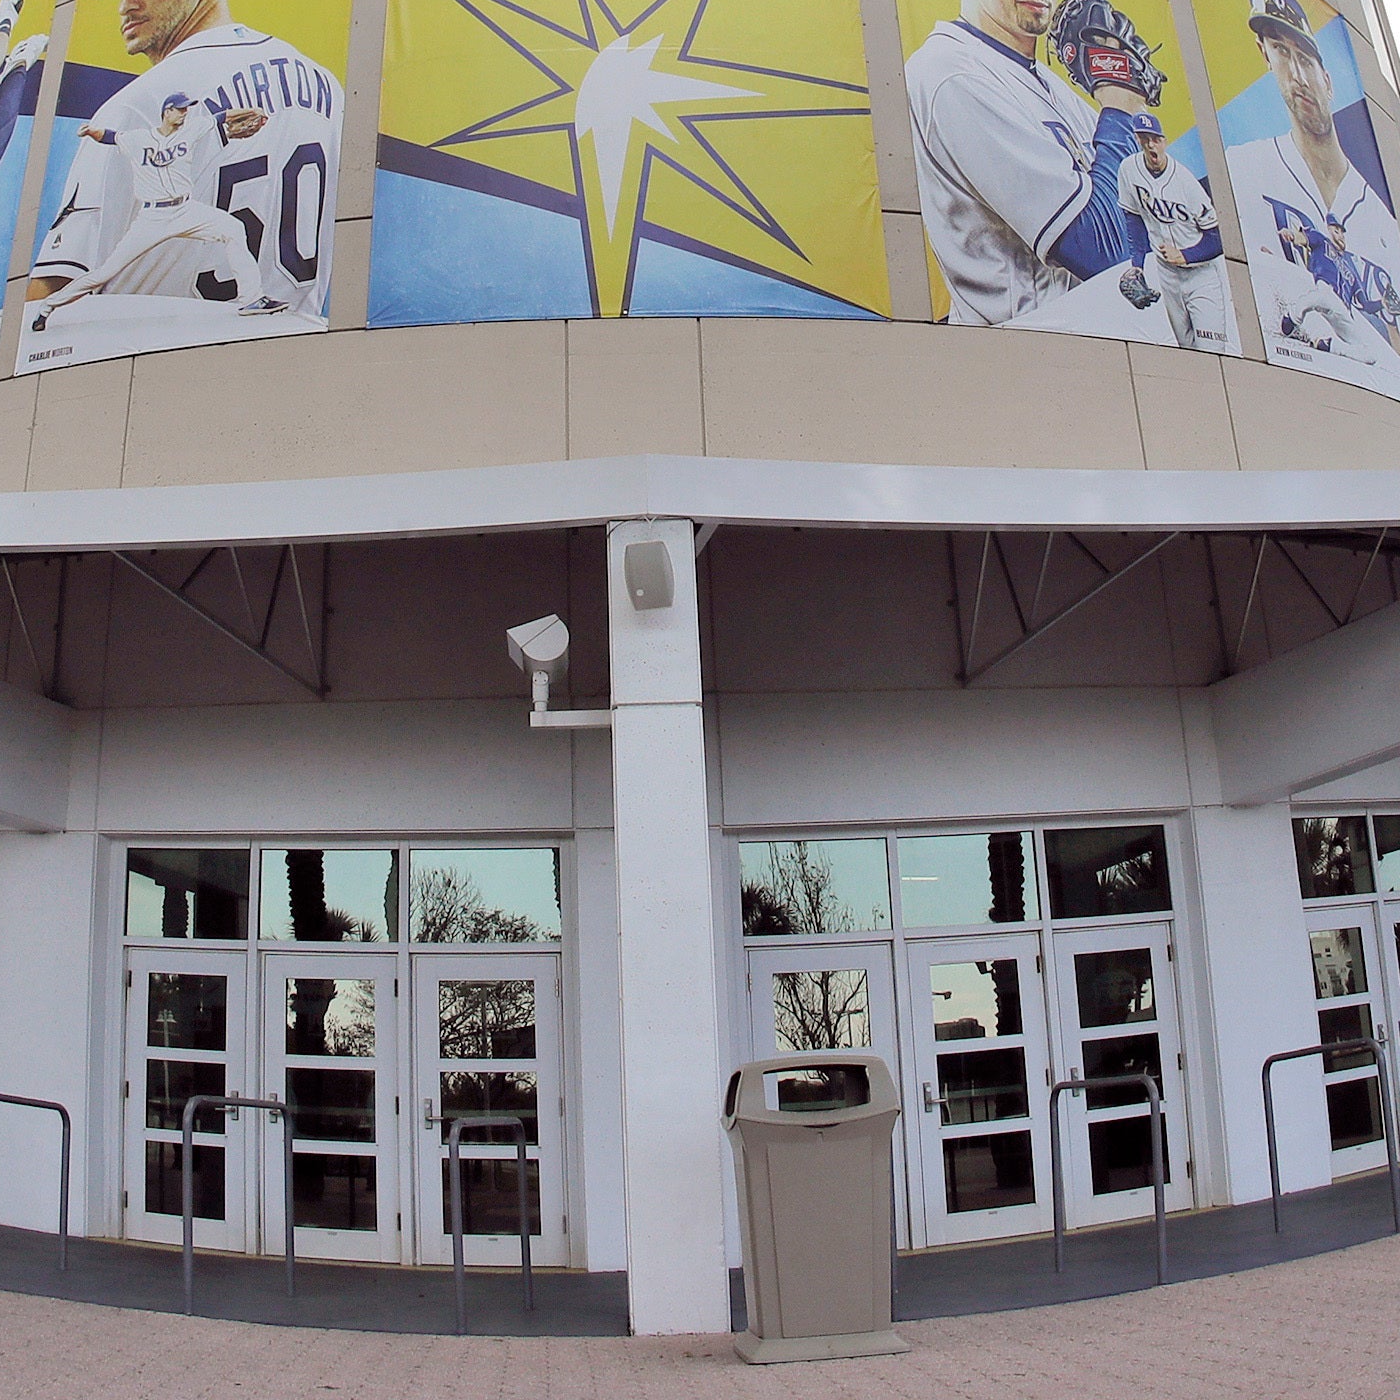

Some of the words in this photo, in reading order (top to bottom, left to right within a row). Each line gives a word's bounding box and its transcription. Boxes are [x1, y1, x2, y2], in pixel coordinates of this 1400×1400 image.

[204, 57, 333, 148] MORTON
[195, 141, 327, 302] 50
[1132, 183, 1190, 224] RAYS
